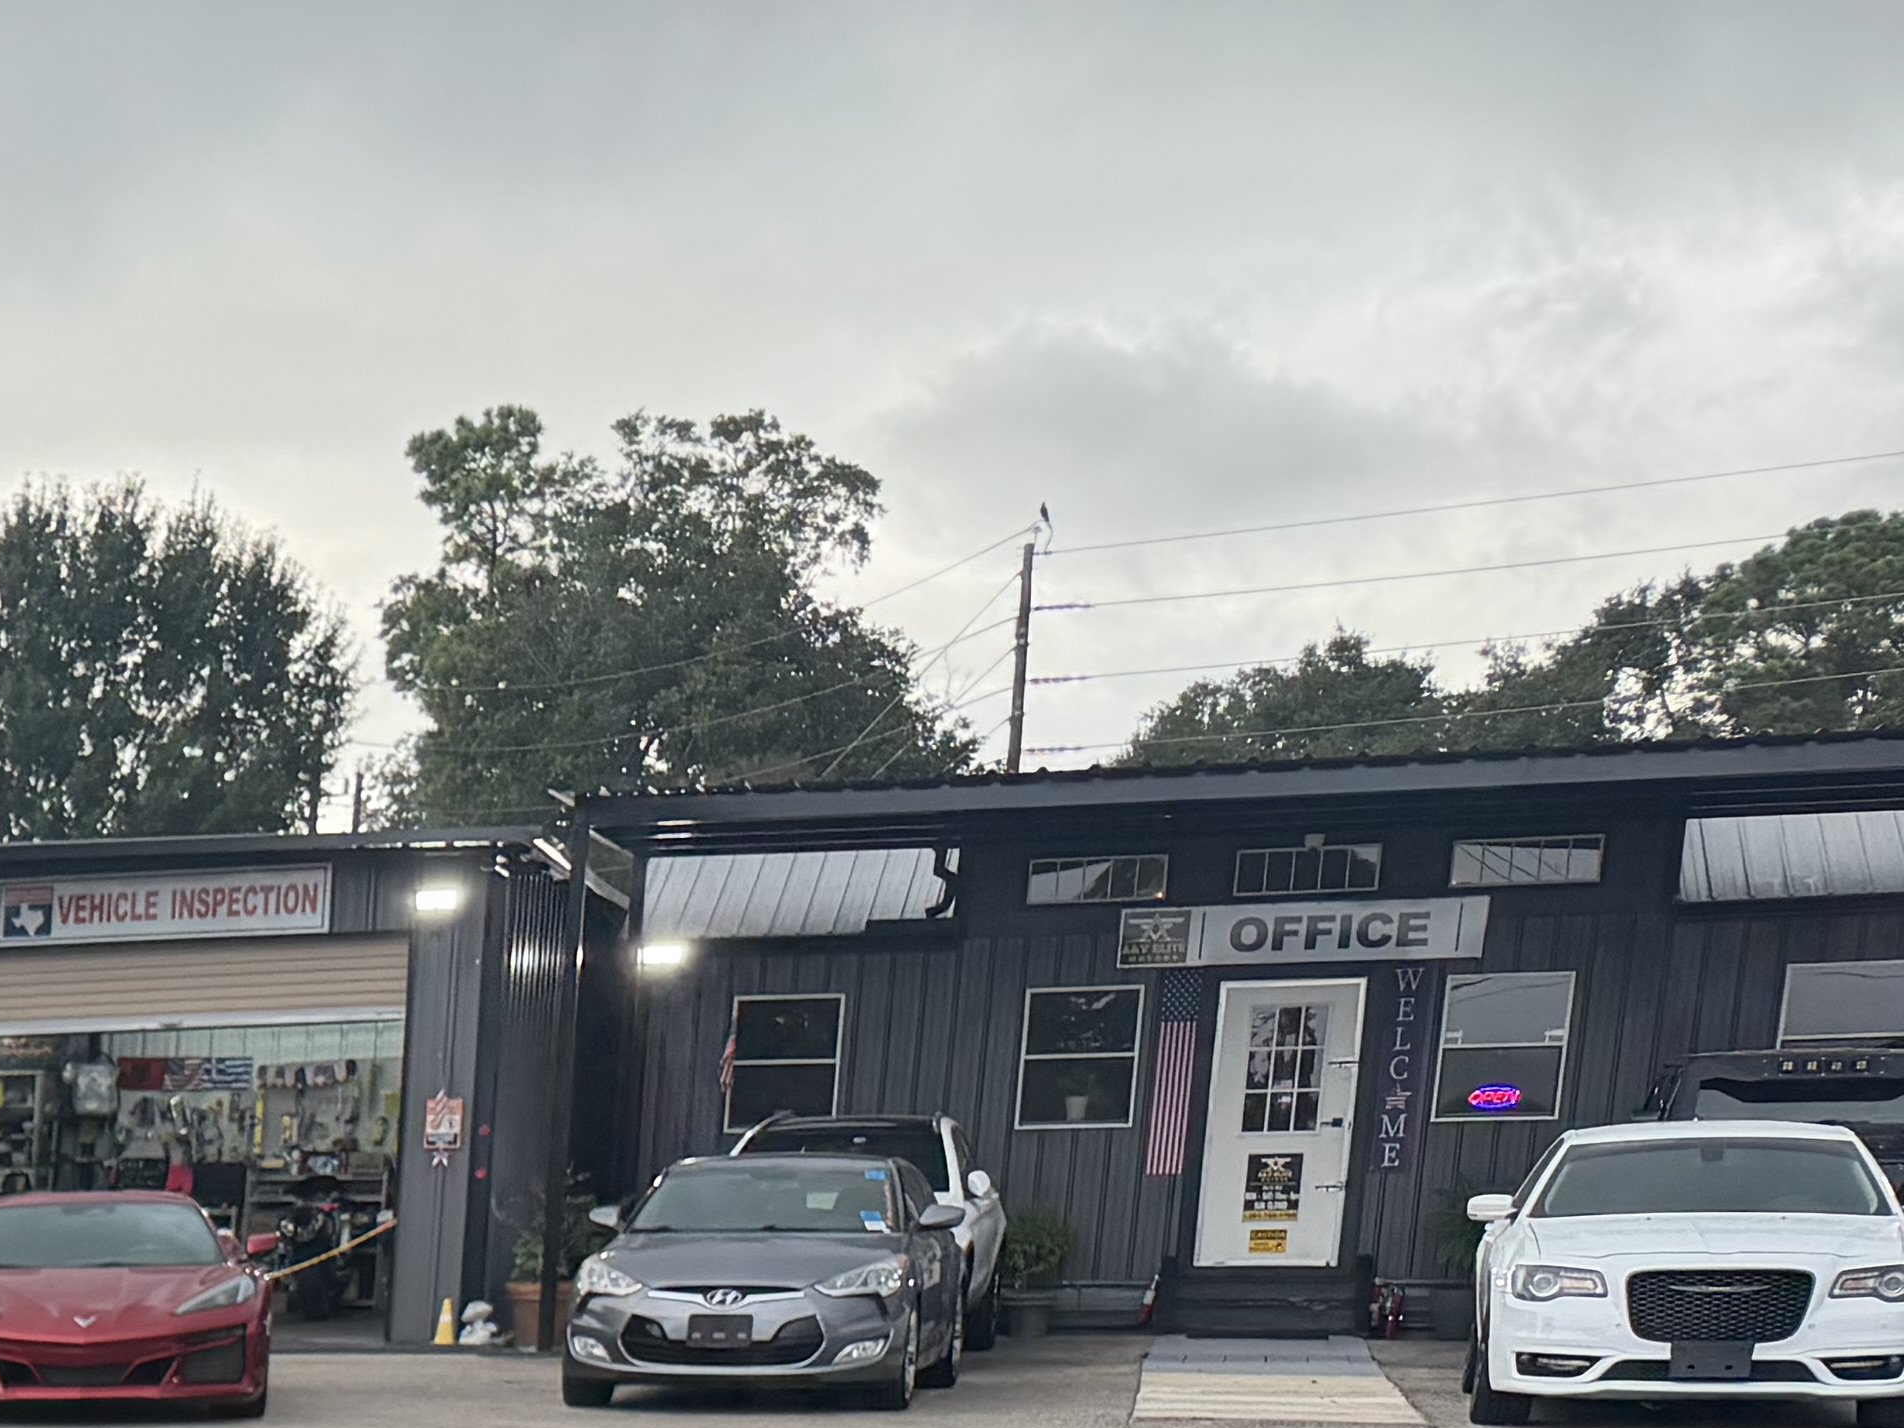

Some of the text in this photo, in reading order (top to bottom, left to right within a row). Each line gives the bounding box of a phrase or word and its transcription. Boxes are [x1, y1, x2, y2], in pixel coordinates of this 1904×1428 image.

[57, 882, 319, 925] VEHICLE INSPECTION
[1229, 911, 1431, 953] OFFICE
[1378, 967, 1425, 1168] WELCME
[1467, 1090, 1520, 1105] OPEN
